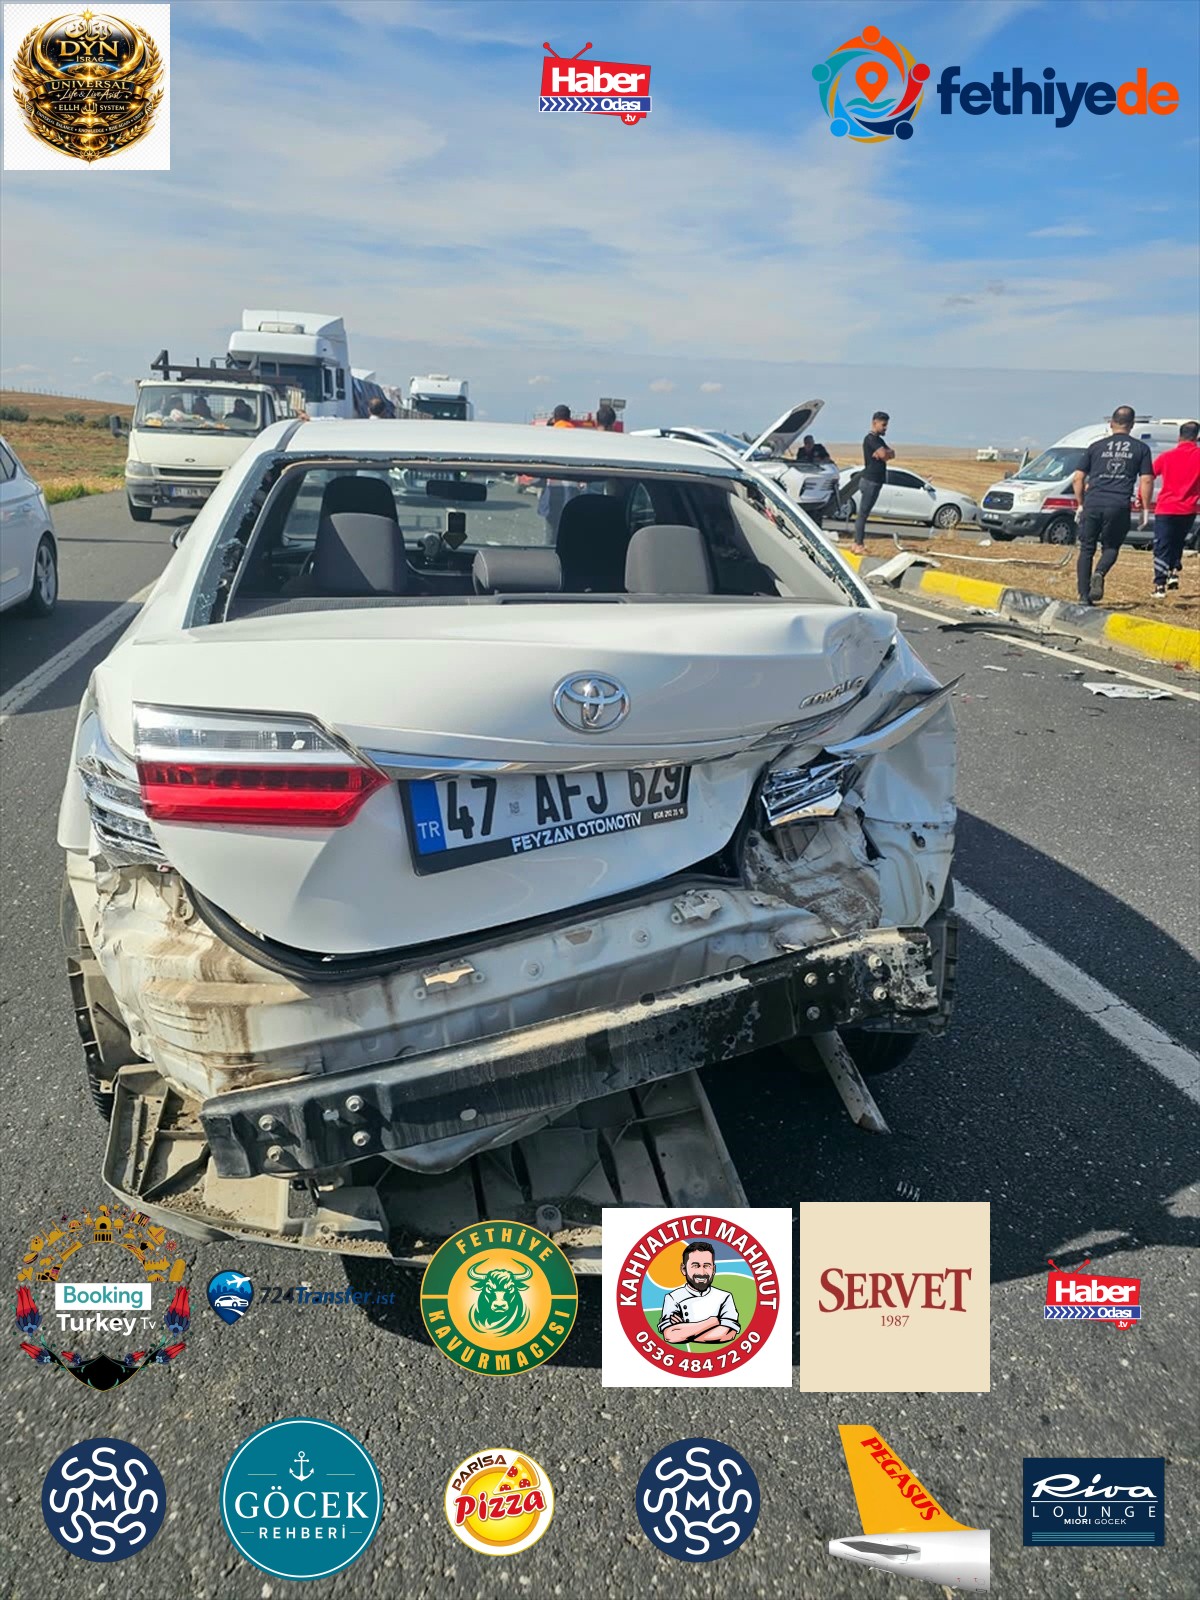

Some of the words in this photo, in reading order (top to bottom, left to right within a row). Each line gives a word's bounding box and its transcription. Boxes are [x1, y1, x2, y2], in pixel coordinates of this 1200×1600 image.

[1106, 440, 1131, 451] 112
[446, 778, 498, 840] 47
[417, 820, 441, 840] TR
[511, 825, 576, 853] FEYZAN
